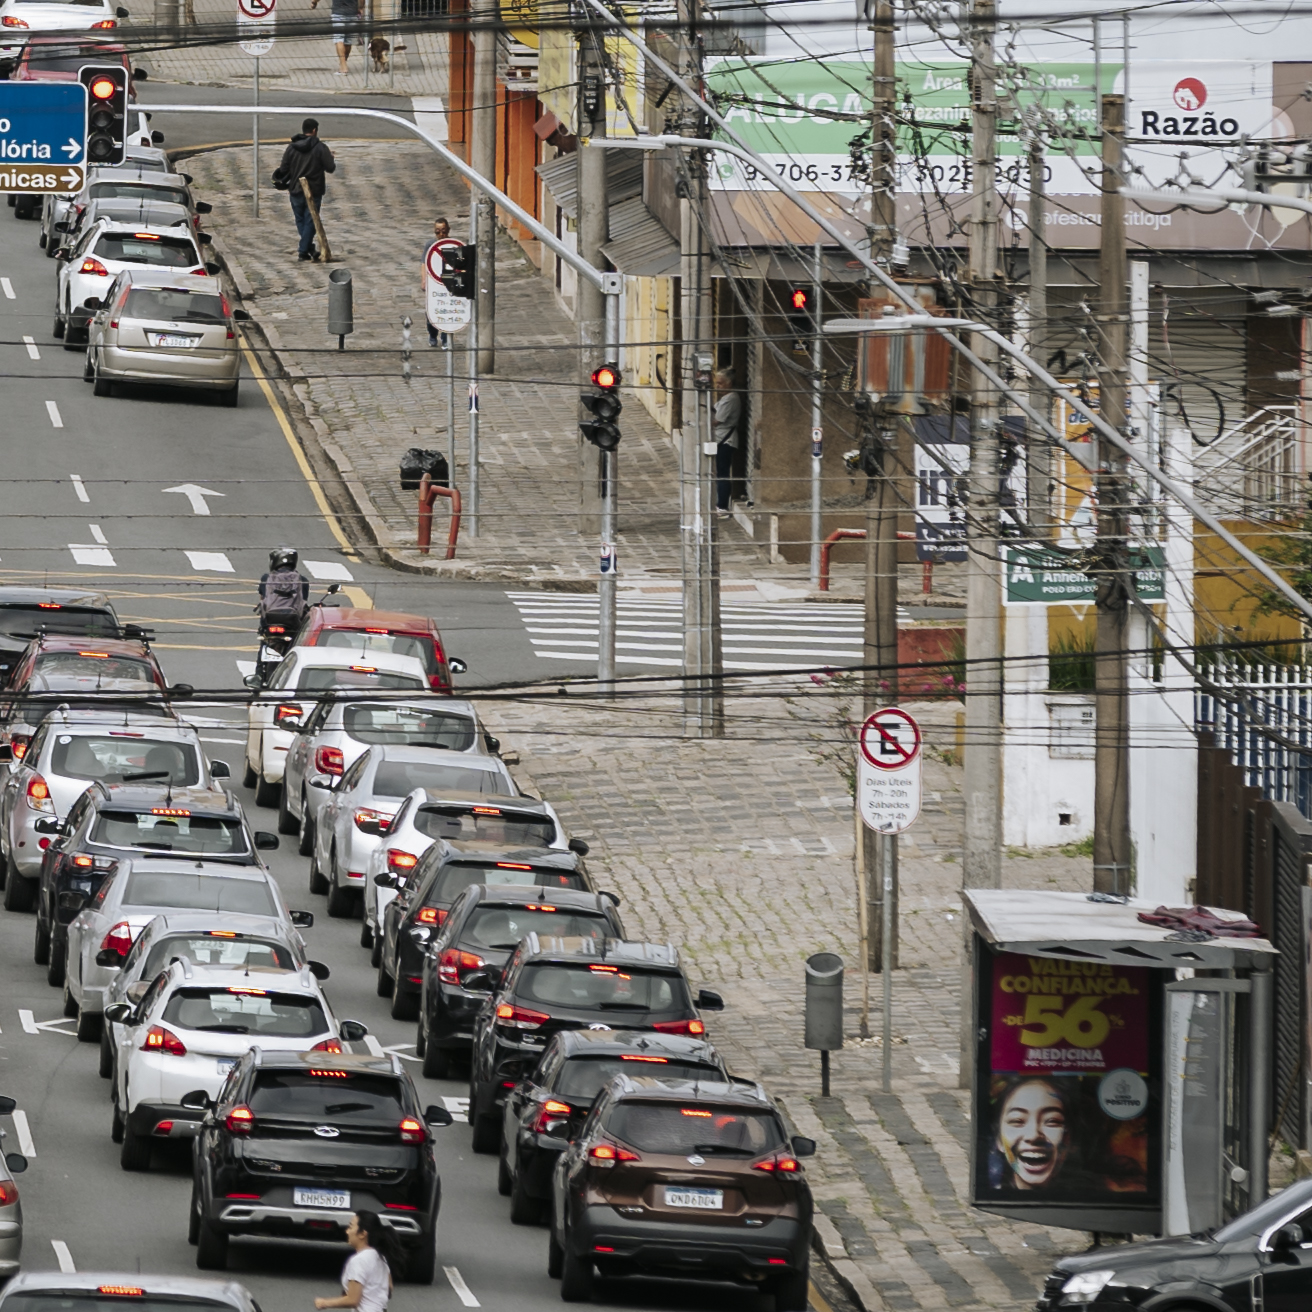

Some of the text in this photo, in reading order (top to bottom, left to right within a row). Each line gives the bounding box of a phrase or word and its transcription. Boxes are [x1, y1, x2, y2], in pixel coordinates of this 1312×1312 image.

[922, 69, 963, 90] Área
[1141, 110, 1240, 136] Razão
[866, 776, 913, 786] Dias Úteis
[868, 800, 910, 809] Sábados
[1000, 975, 1140, 995] CONFIANÇA.
[1020, 994, 1111, 1048] 56
[1028, 1048, 1103, 1061] MEDICINA
